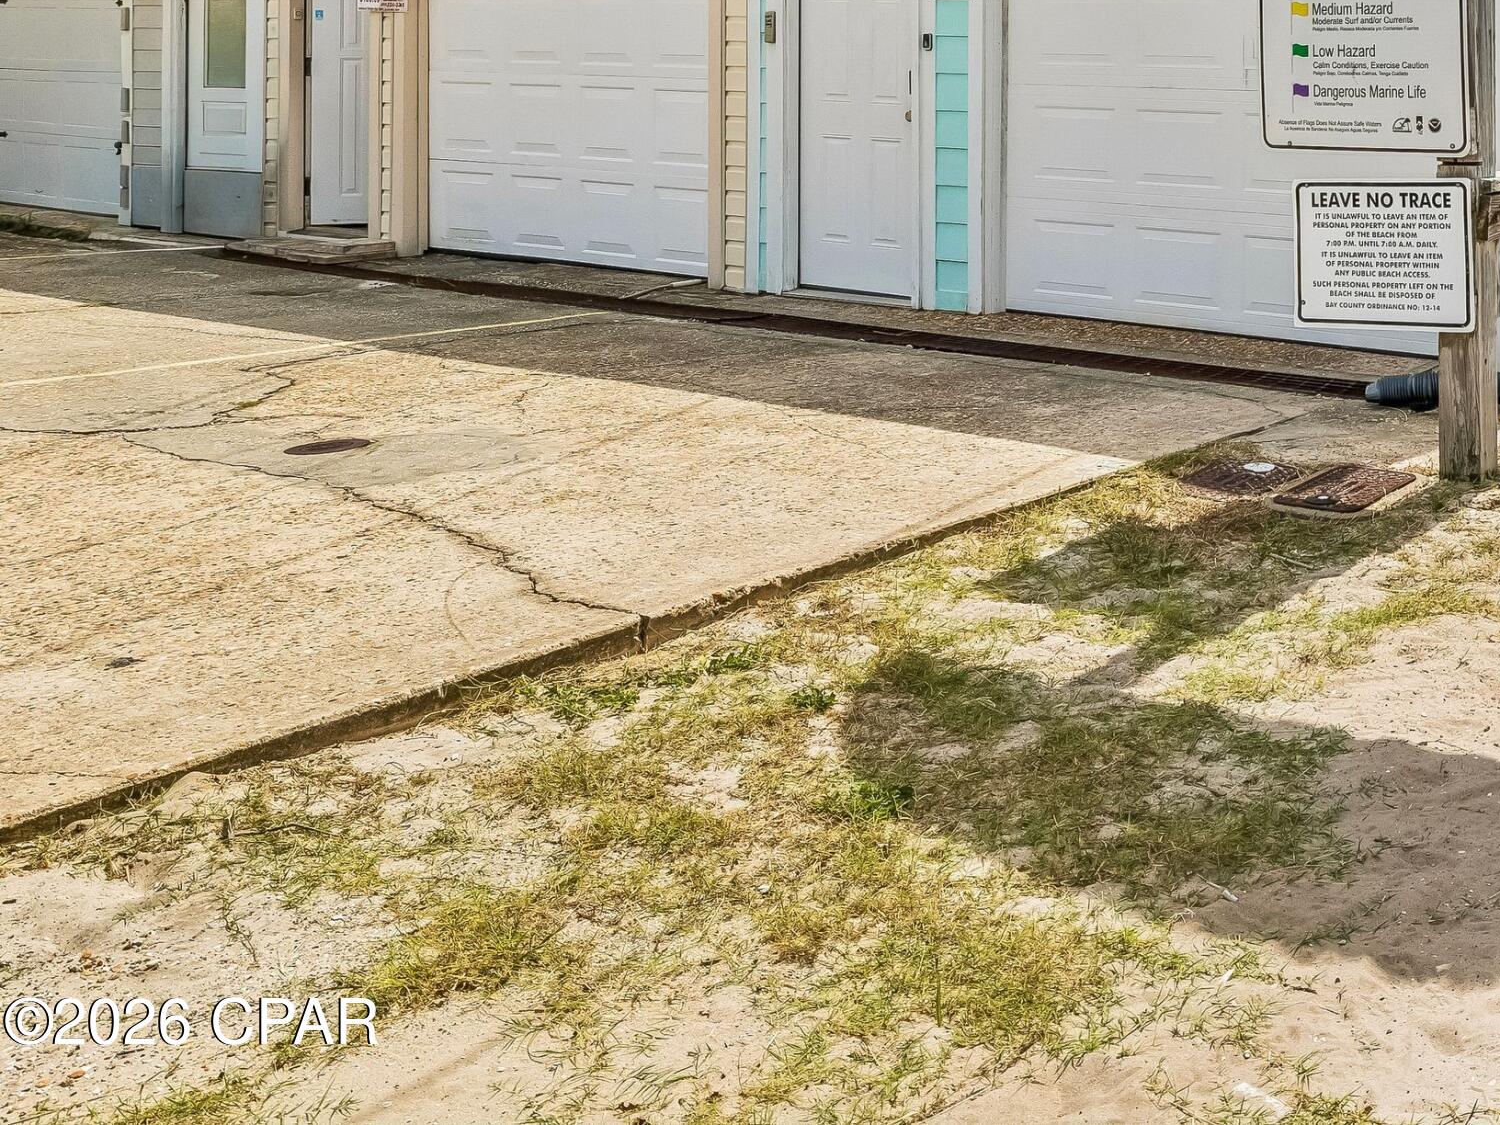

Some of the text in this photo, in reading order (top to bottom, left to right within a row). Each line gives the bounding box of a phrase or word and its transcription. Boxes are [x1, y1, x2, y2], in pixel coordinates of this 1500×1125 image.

[1312, 1, 1393, 15] Medium Hazard
[1312, 17, 1343, 25] Moderate
[1312, 44, 1376, 57] Low Hazard
[1331, 62, 1368, 70] Conditions,
[1313, 85, 1426, 101] Dangerous Marine Life
[1311, 192, 1452, 208] LEAVE NO TRACE
[1337, 251, 1376, 259] UNLAWFUL
[1312, 280, 1331, 288] SUCH
[1333, 281, 1370, 289] PERSONAL
[1408, 282, 1424, 290] LEFT
[1440, 283, 1454, 291] THE
[1388, 291, 1423, 299] DISPOSED
